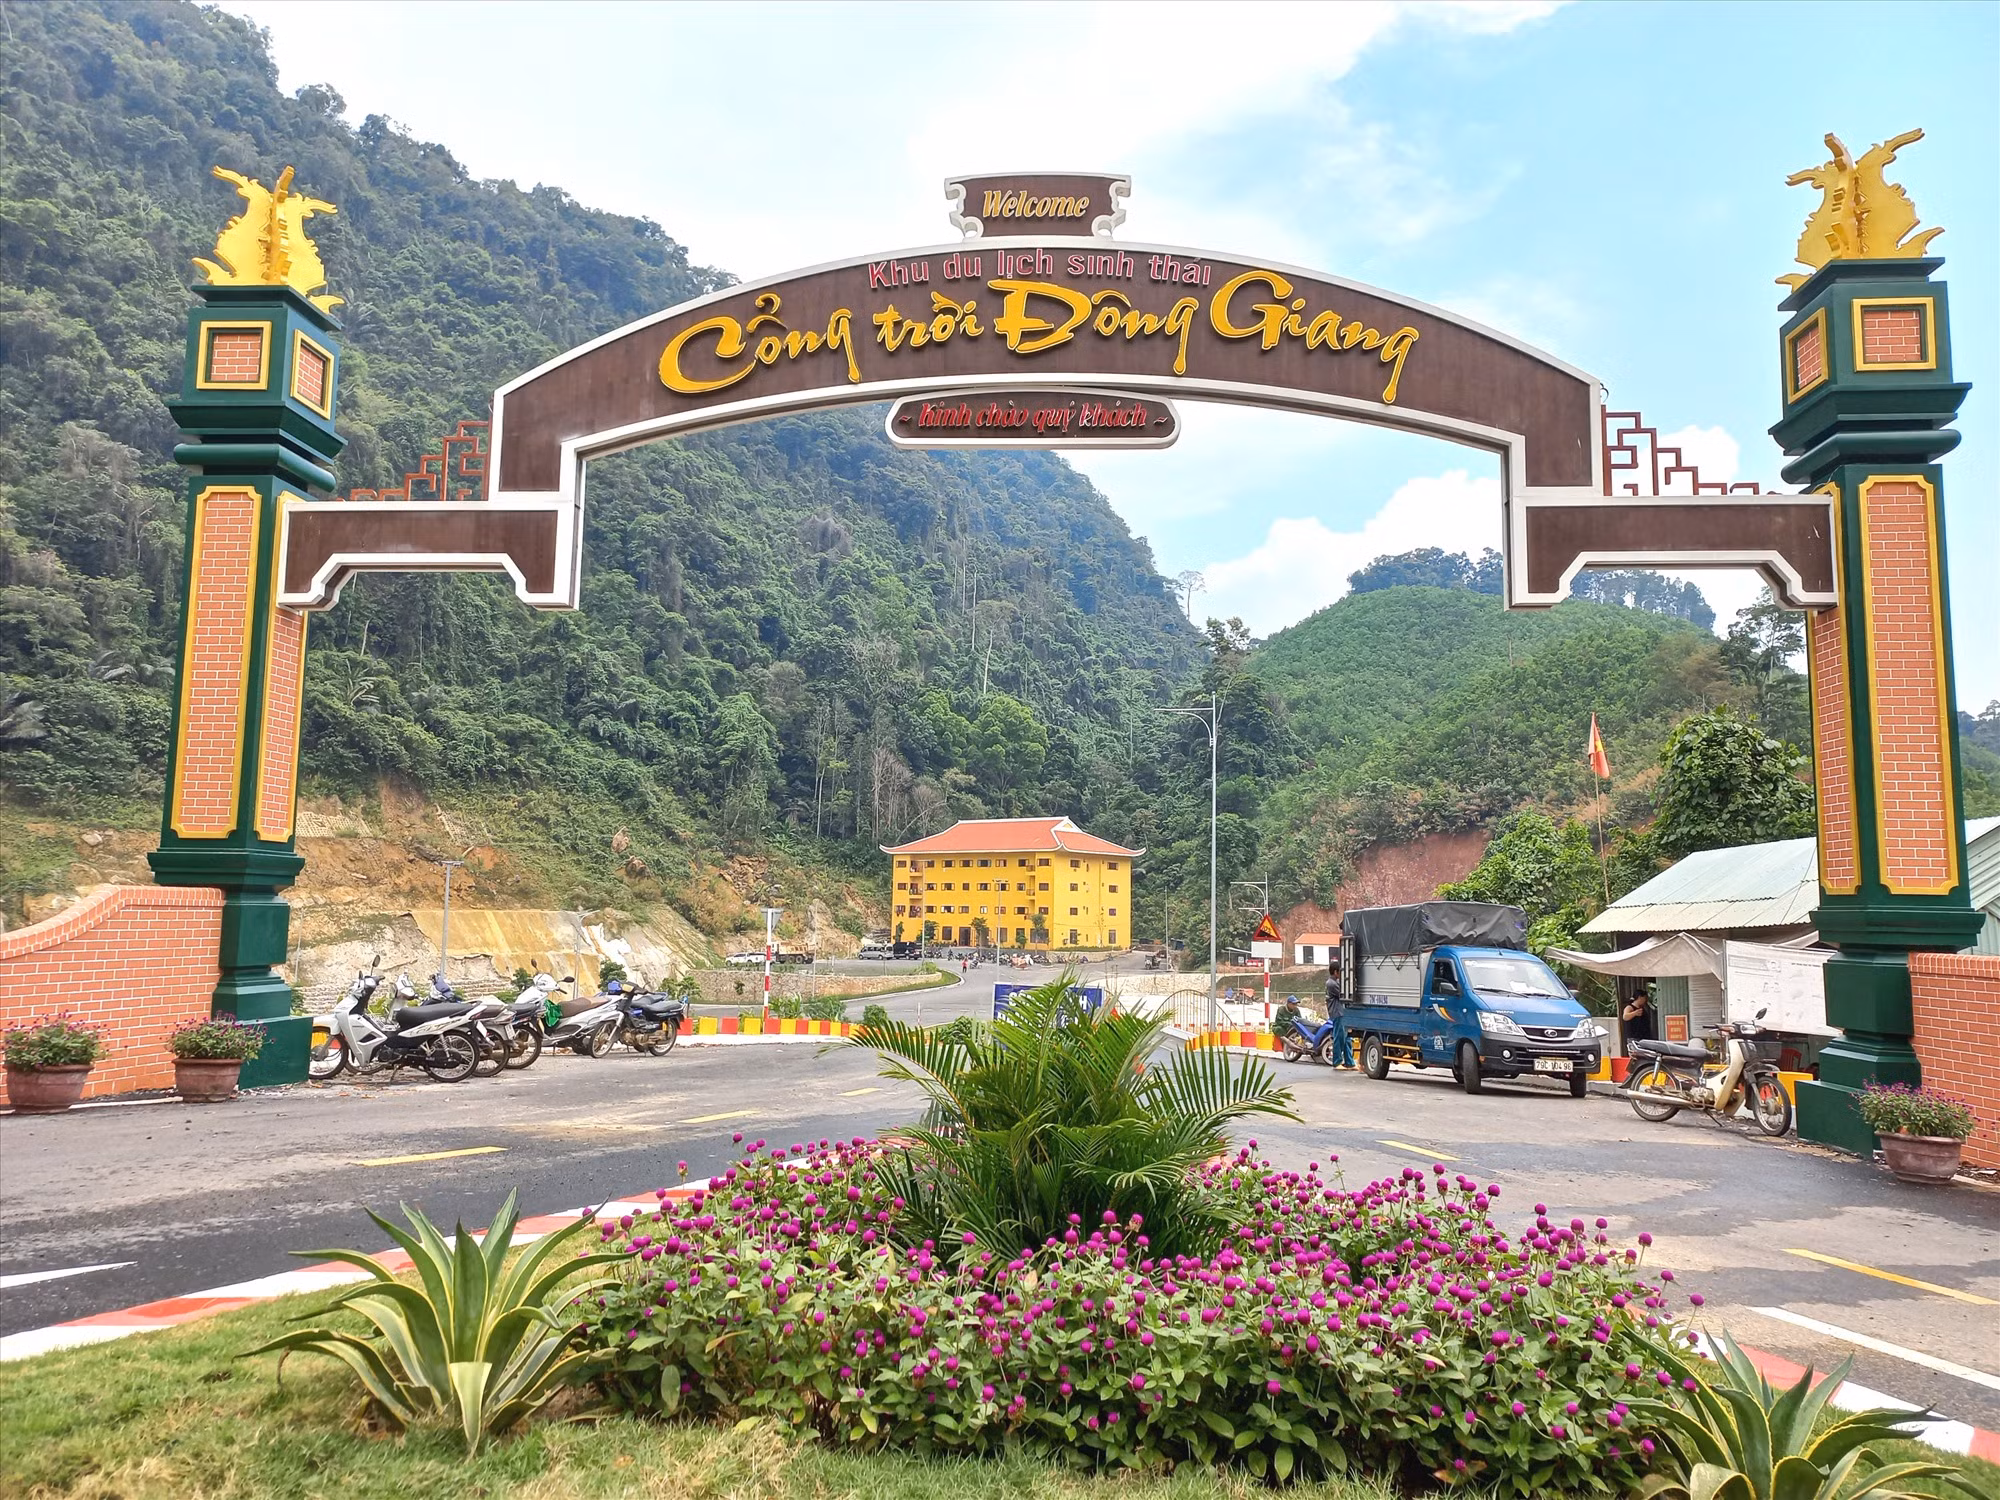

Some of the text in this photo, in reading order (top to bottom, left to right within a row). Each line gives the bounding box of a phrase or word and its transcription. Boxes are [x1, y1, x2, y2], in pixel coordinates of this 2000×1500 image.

[982, 189, 1090, 218] Welcome
[868, 248, 1212, 289] Khu du lịch sinh thái
[658, 270, 1419, 405] Cổng trời Đông Giang
[918, 400, 1147, 433] Kính chào quý khách
